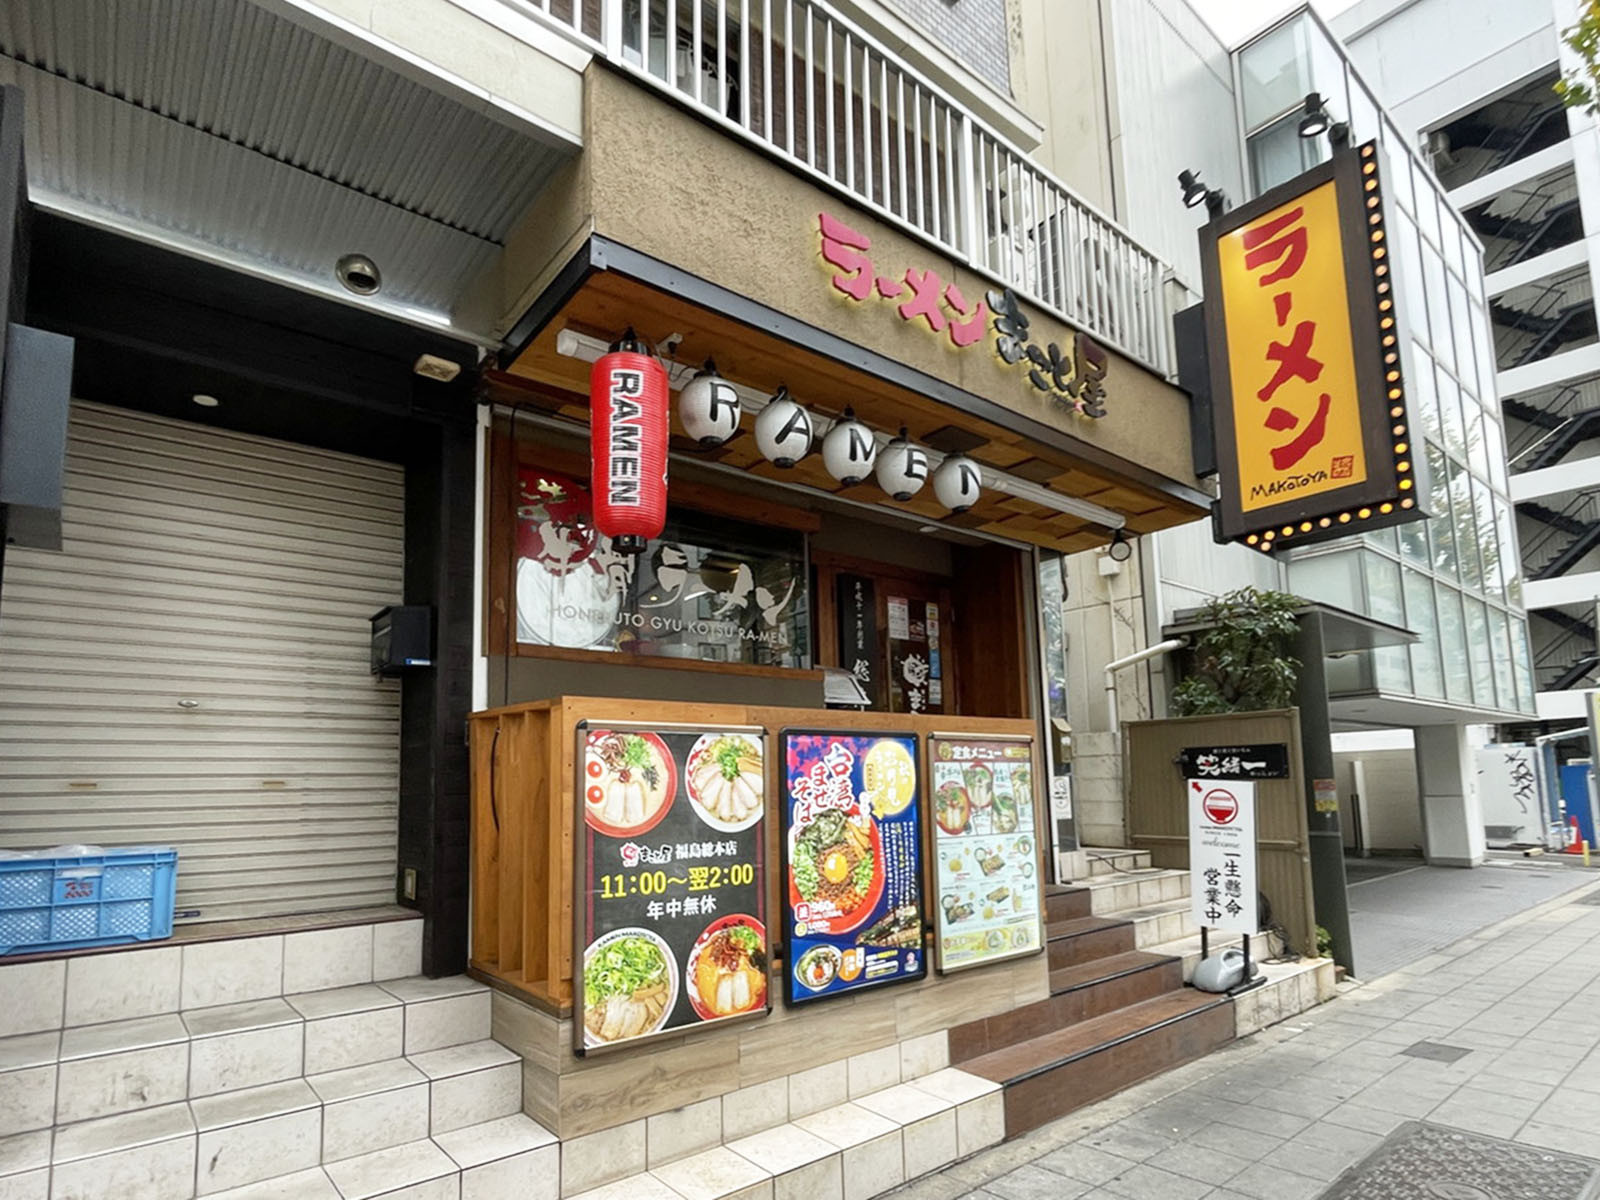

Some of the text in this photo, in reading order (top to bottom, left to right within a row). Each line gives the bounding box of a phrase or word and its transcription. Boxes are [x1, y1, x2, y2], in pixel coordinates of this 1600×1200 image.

[1242, 206, 1331, 471] ラーメン
[609, 370, 643, 506] RAMEN
[650, 616, 682, 633] GYU
[687, 623, 734, 640] KOTSU
[738, 627, 788, 645] RA-MEN
[646, 894, 717, 921] 年中無休
[1203, 867, 1222, 925] 営業中
[1223, 852, 1243, 918] 一生懸命
